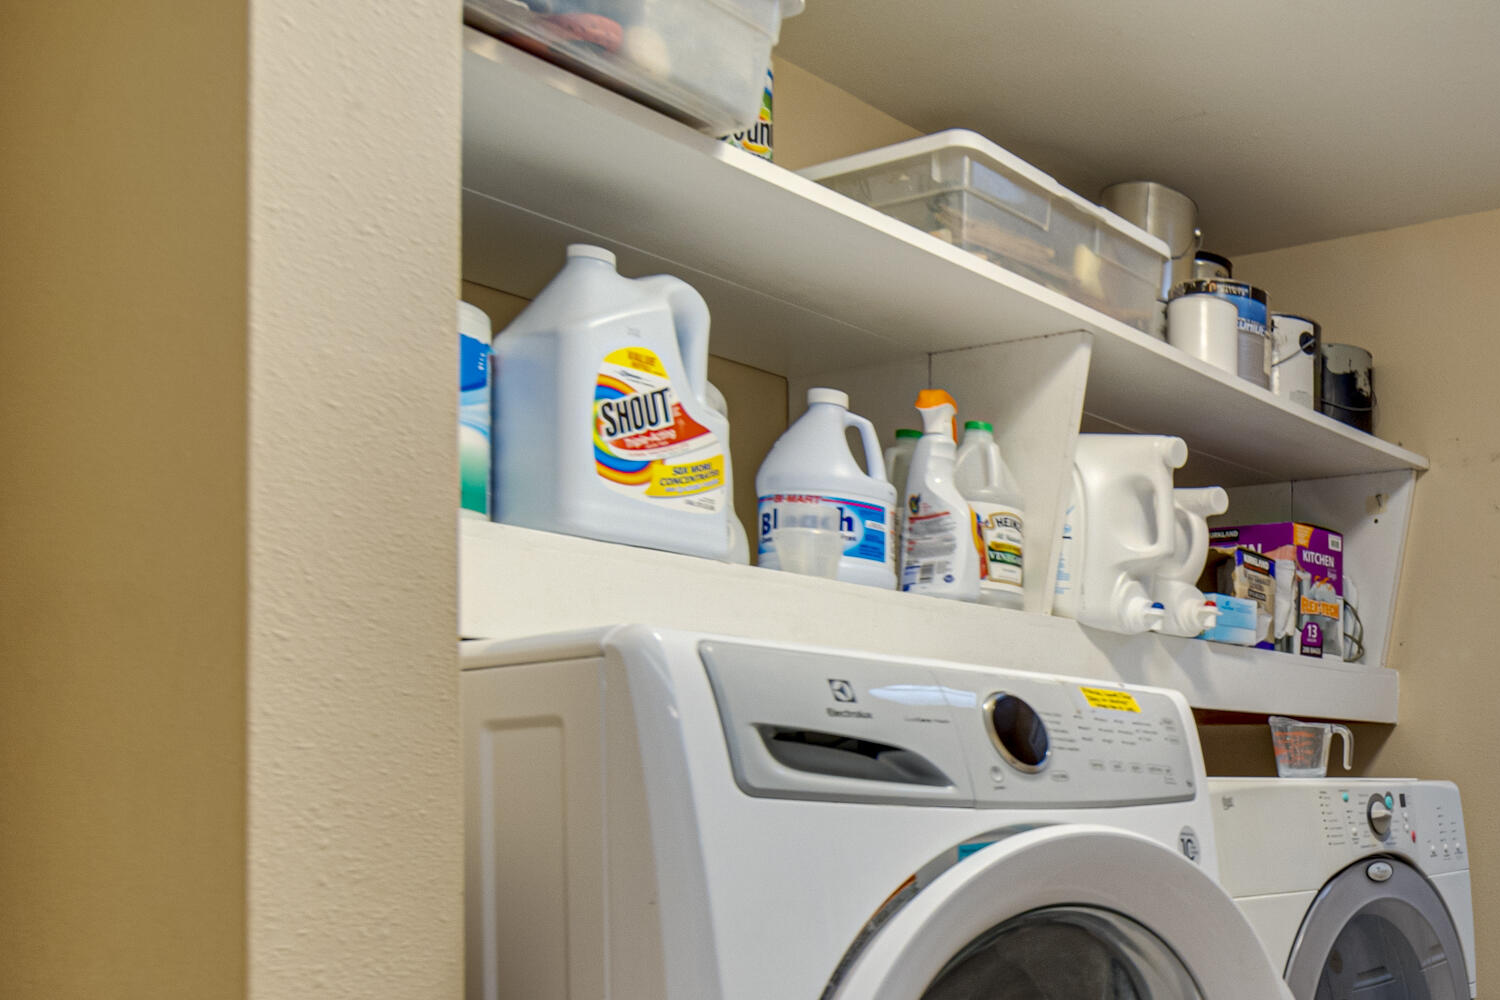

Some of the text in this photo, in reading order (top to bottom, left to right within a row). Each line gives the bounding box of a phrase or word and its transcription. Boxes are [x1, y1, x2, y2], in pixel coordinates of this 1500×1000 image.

[601, 387, 669, 438] SHOUT
[1302, 549, 1335, 569] KITCHEN
[1306, 623, 1318, 639] 13
